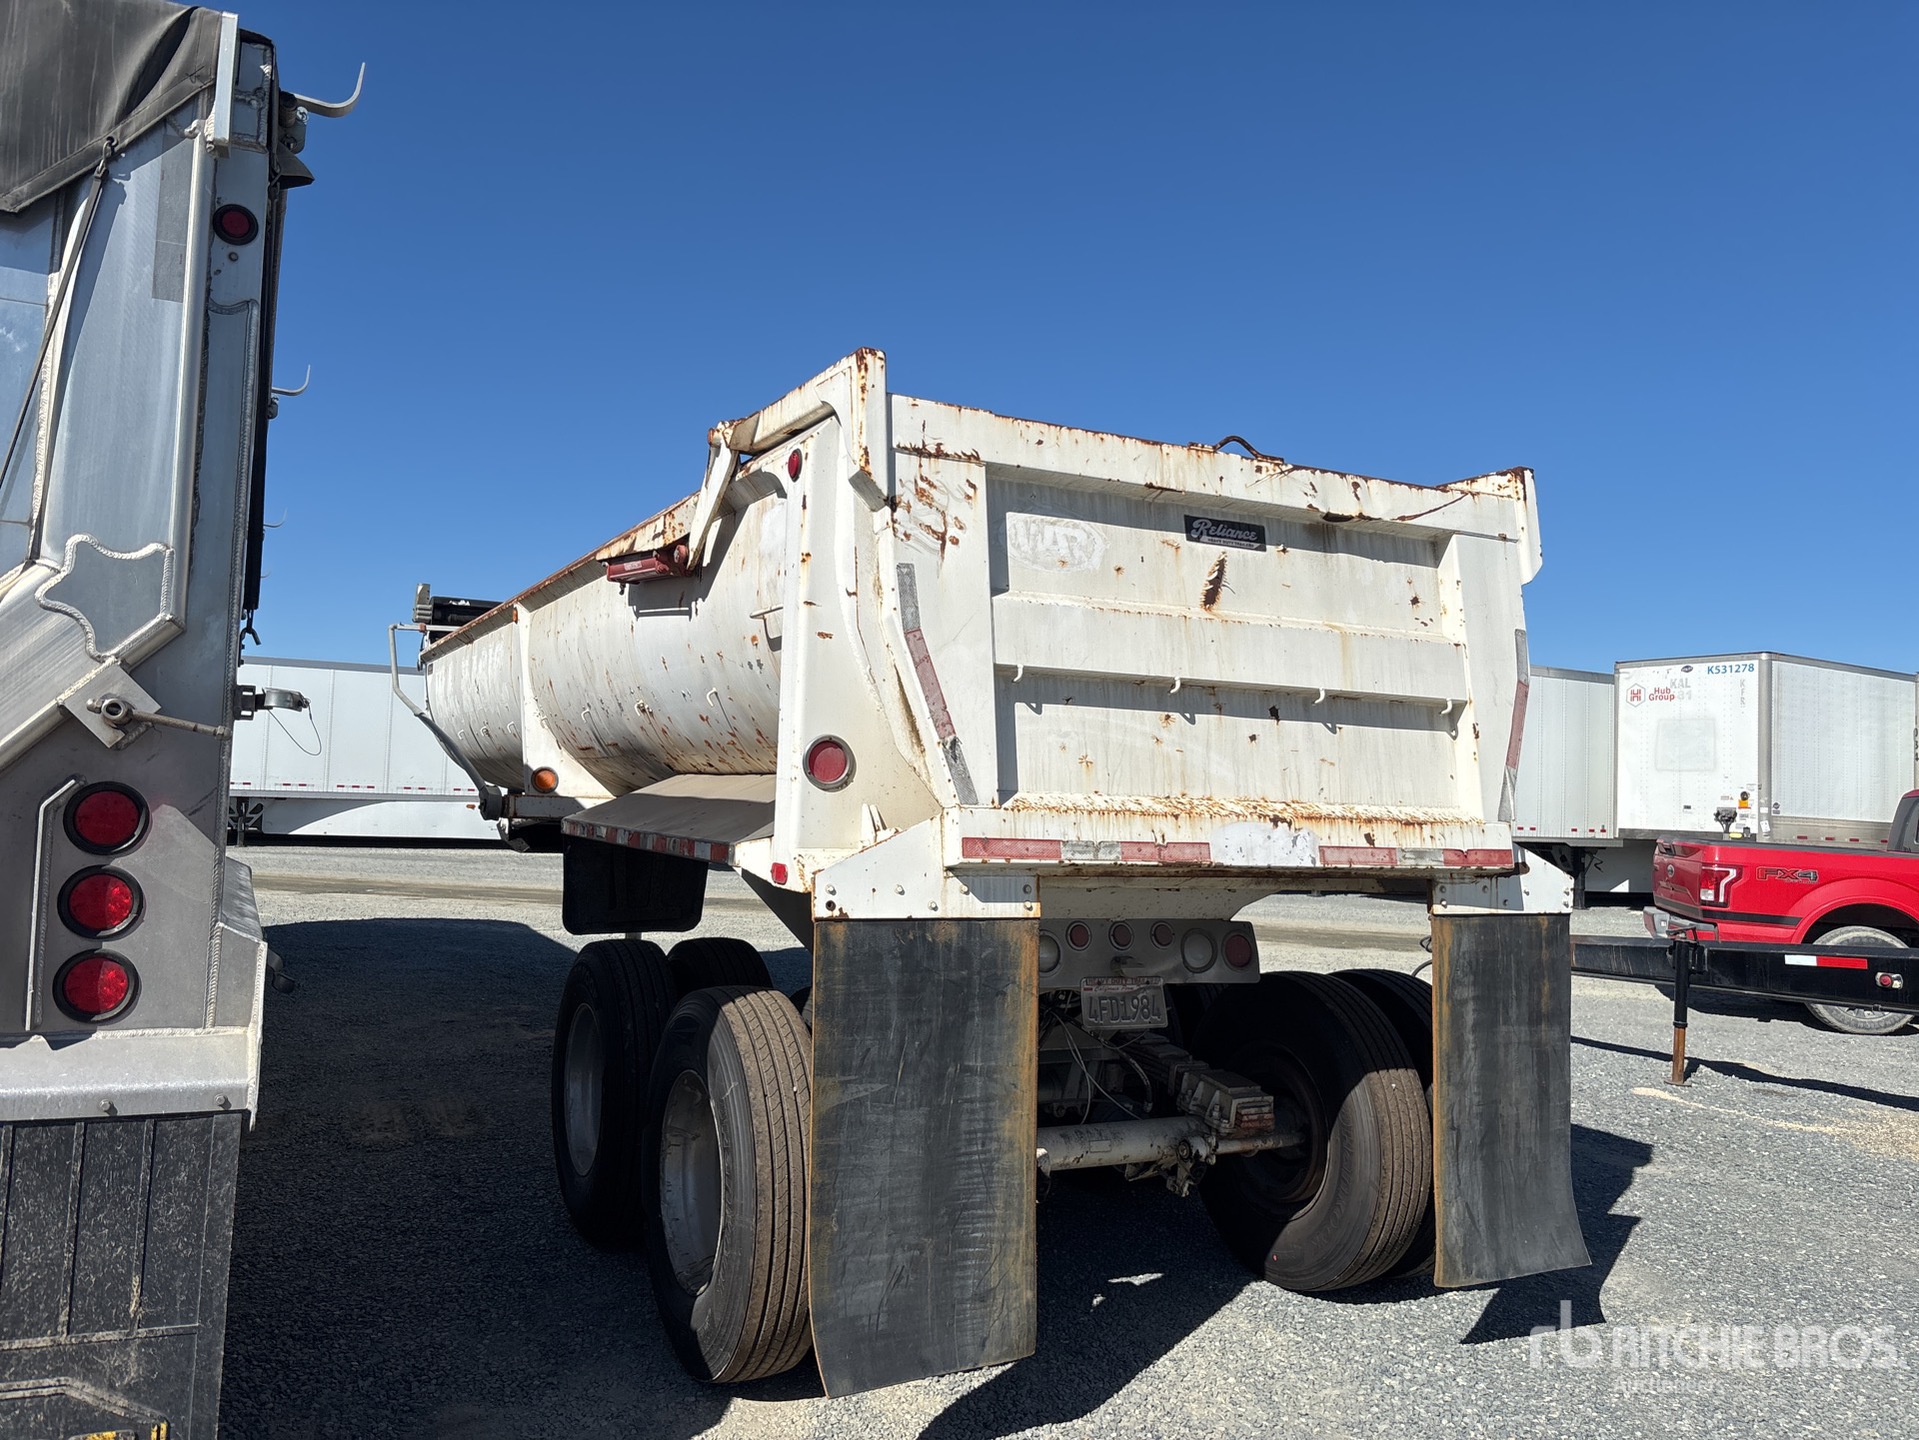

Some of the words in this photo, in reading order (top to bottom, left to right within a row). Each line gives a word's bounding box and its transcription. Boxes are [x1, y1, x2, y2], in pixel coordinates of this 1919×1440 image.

[1190, 518, 1258, 541] Reliance
[1707, 663, 1755, 675] K531278
[1648, 693, 1676, 702] Group
[1654, 686, 1671, 695] Hub
[1756, 866, 1819, 883] FX4
[1088, 994, 1161, 1023] 4FD1984
